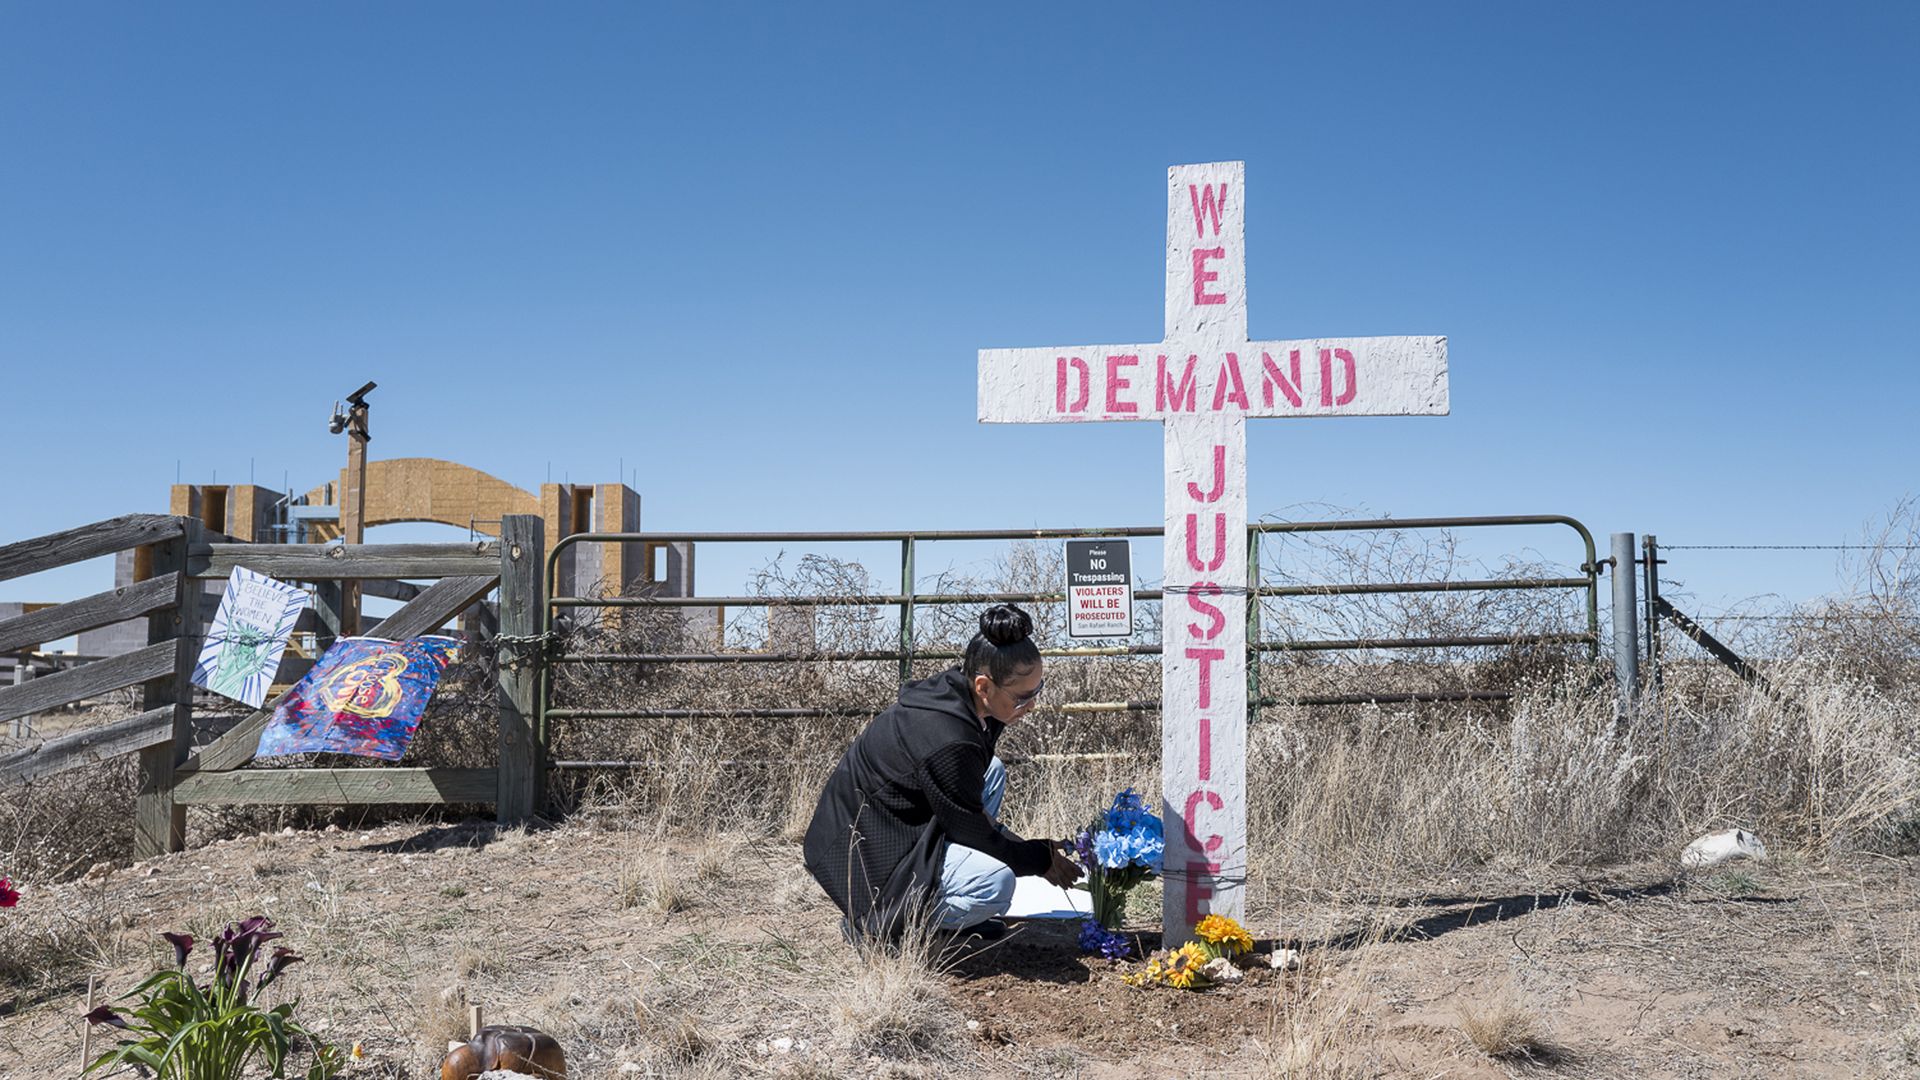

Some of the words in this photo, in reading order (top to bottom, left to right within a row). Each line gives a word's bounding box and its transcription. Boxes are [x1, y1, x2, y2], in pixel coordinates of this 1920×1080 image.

[1189, 183, 1228, 306] WE
[1055, 348, 1358, 414] DEMAND
[1090, 559, 1107, 570] NO
[1073, 572, 1125, 583] Trespassing
[245, 582, 284, 603] BELIEVE
[249, 597, 266, 610] THE
[1080, 600, 1104, 609] WILL
[1107, 599, 1120, 608] BE
[236, 606, 273, 624] WOMEN
[1075, 612, 1126, 620] PROSECUTED
[1185, 445, 1227, 926] JUSTICE
